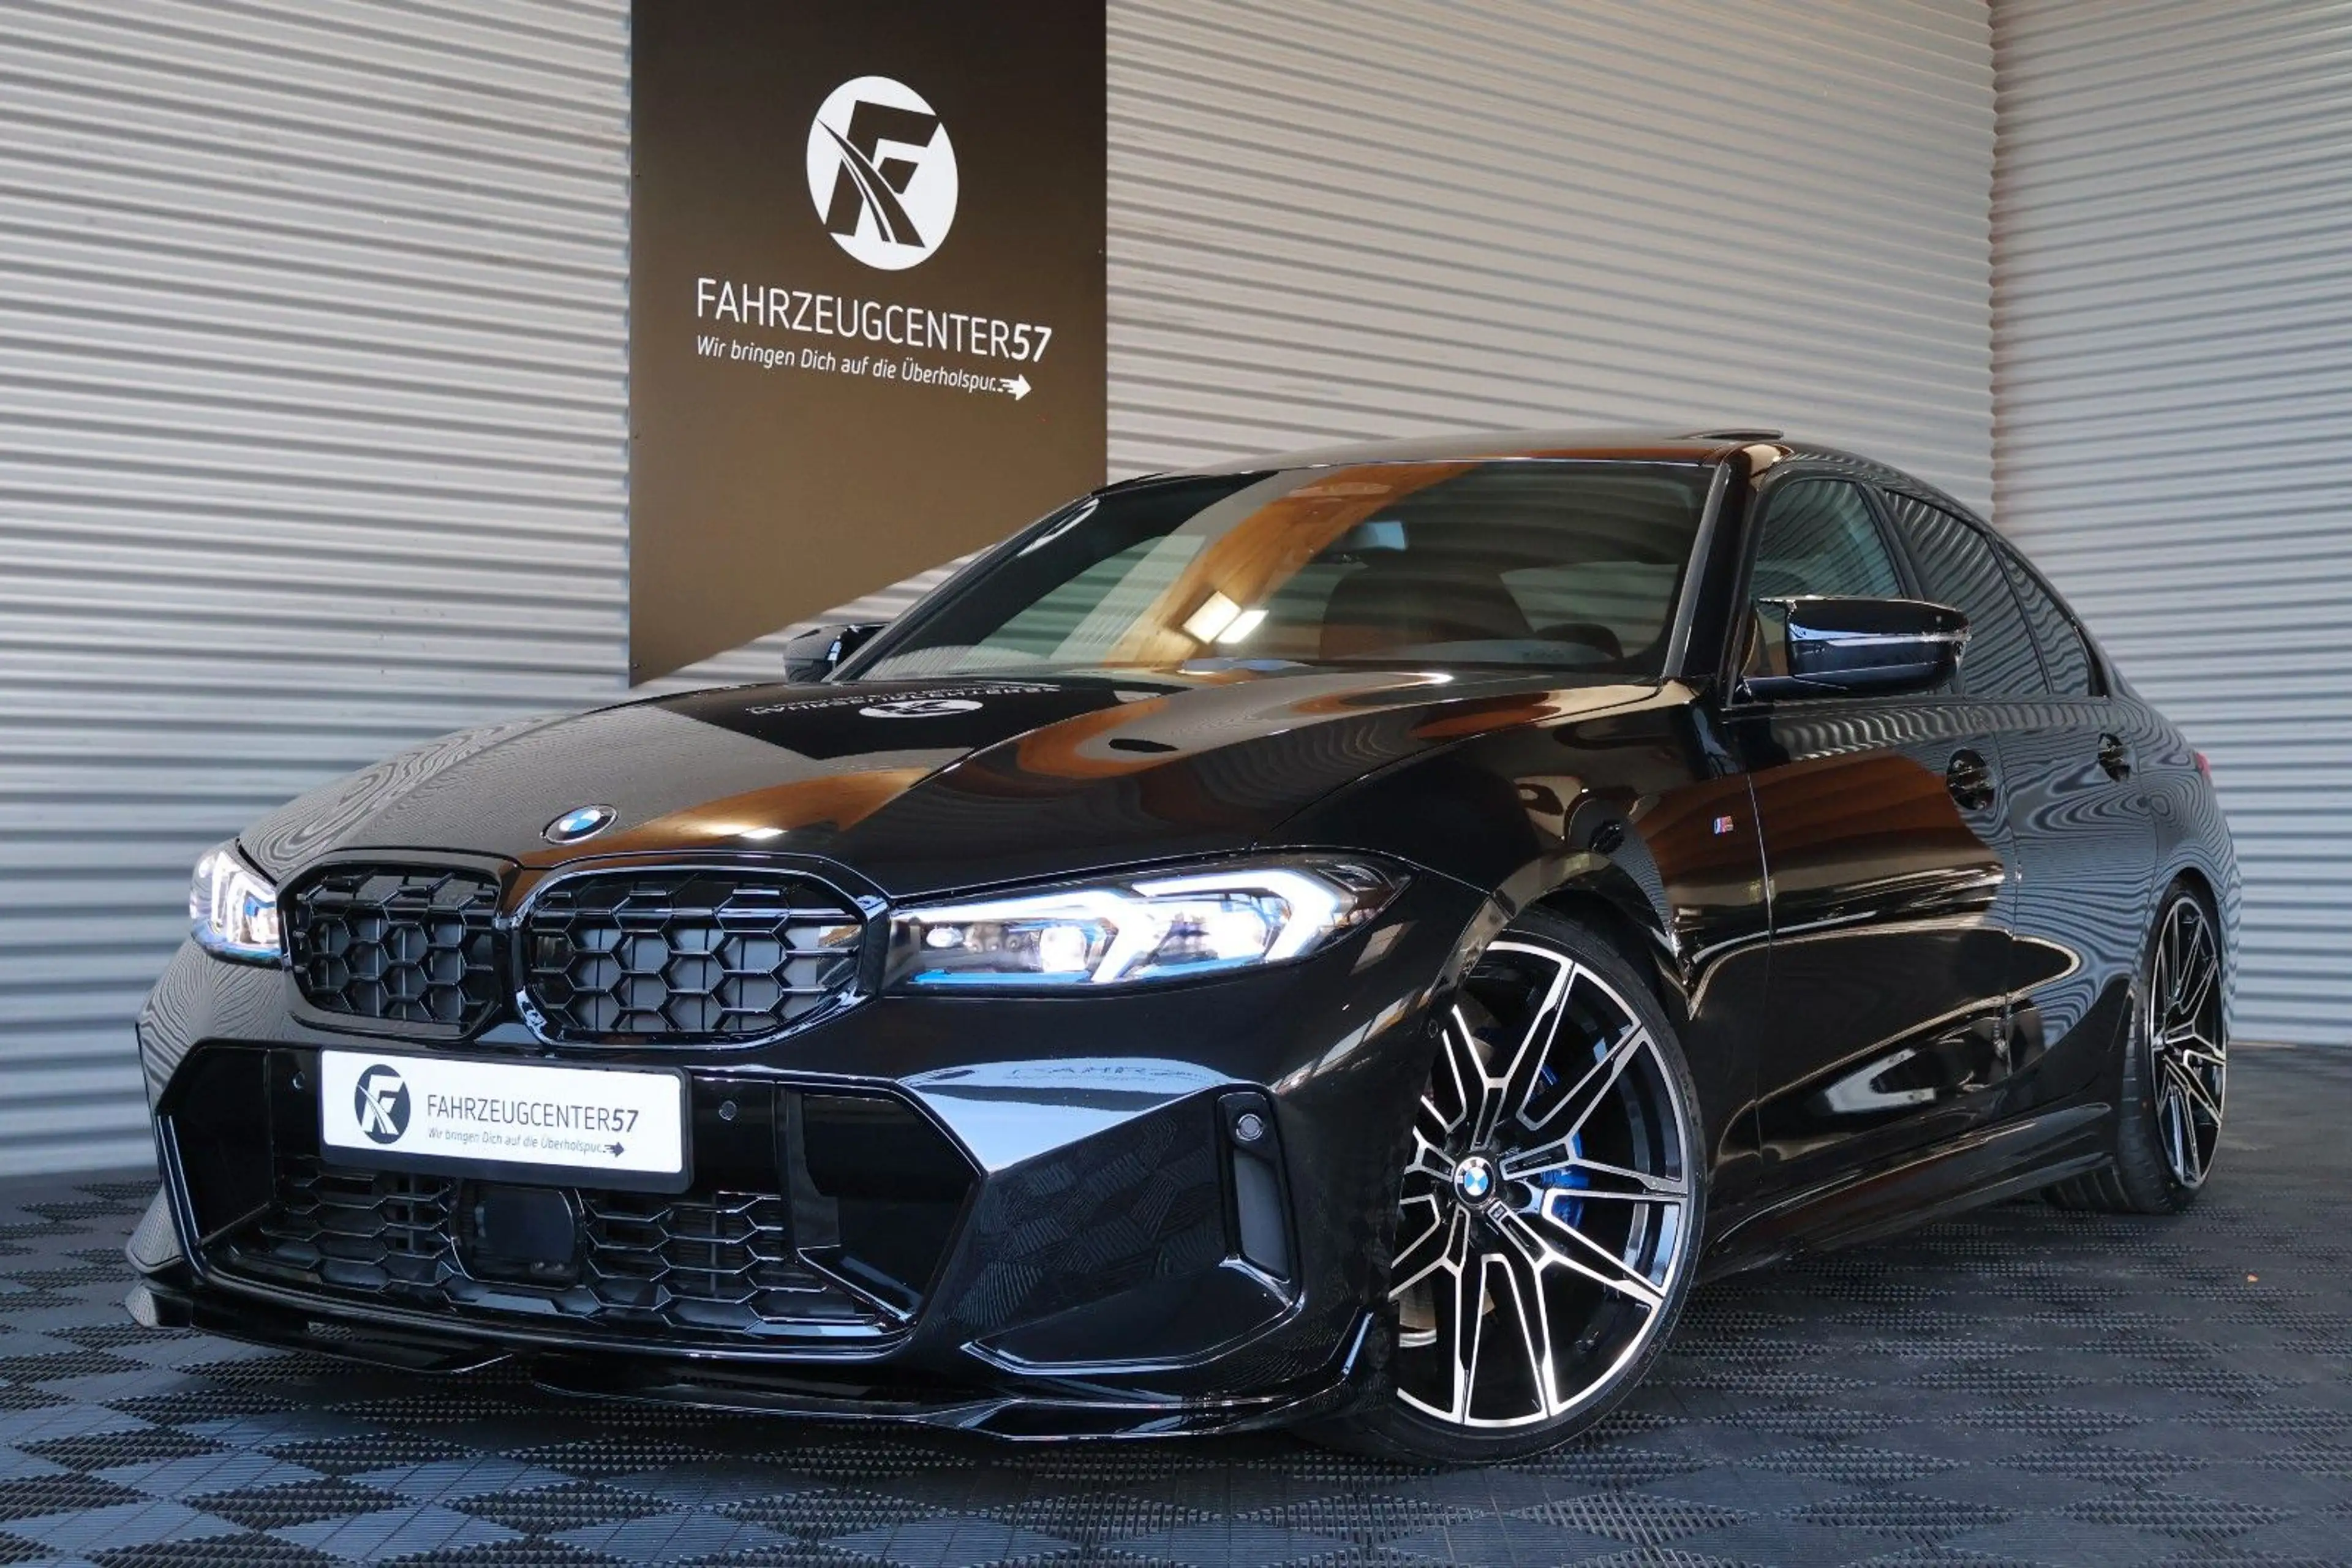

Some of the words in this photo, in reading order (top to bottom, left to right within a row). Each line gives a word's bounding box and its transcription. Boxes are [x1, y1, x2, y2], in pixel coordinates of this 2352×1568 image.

[697, 277, 1052, 363] FAHRZEUGCENTER57
[697, 334, 727, 358] Wir
[730, 339, 796, 369] bringen
[801, 348, 837, 372] Dich
[840, 356, 870, 375] auf
[872, 358, 897, 379] die
[428, 1094, 639, 1133] FAHRZEUGCENTER57
[445, 1129, 480, 1145] bringen
[482, 1130, 503, 1145] Dich
[504, 1134, 521, 1146] auf
[523, 1135, 538, 1148] die
